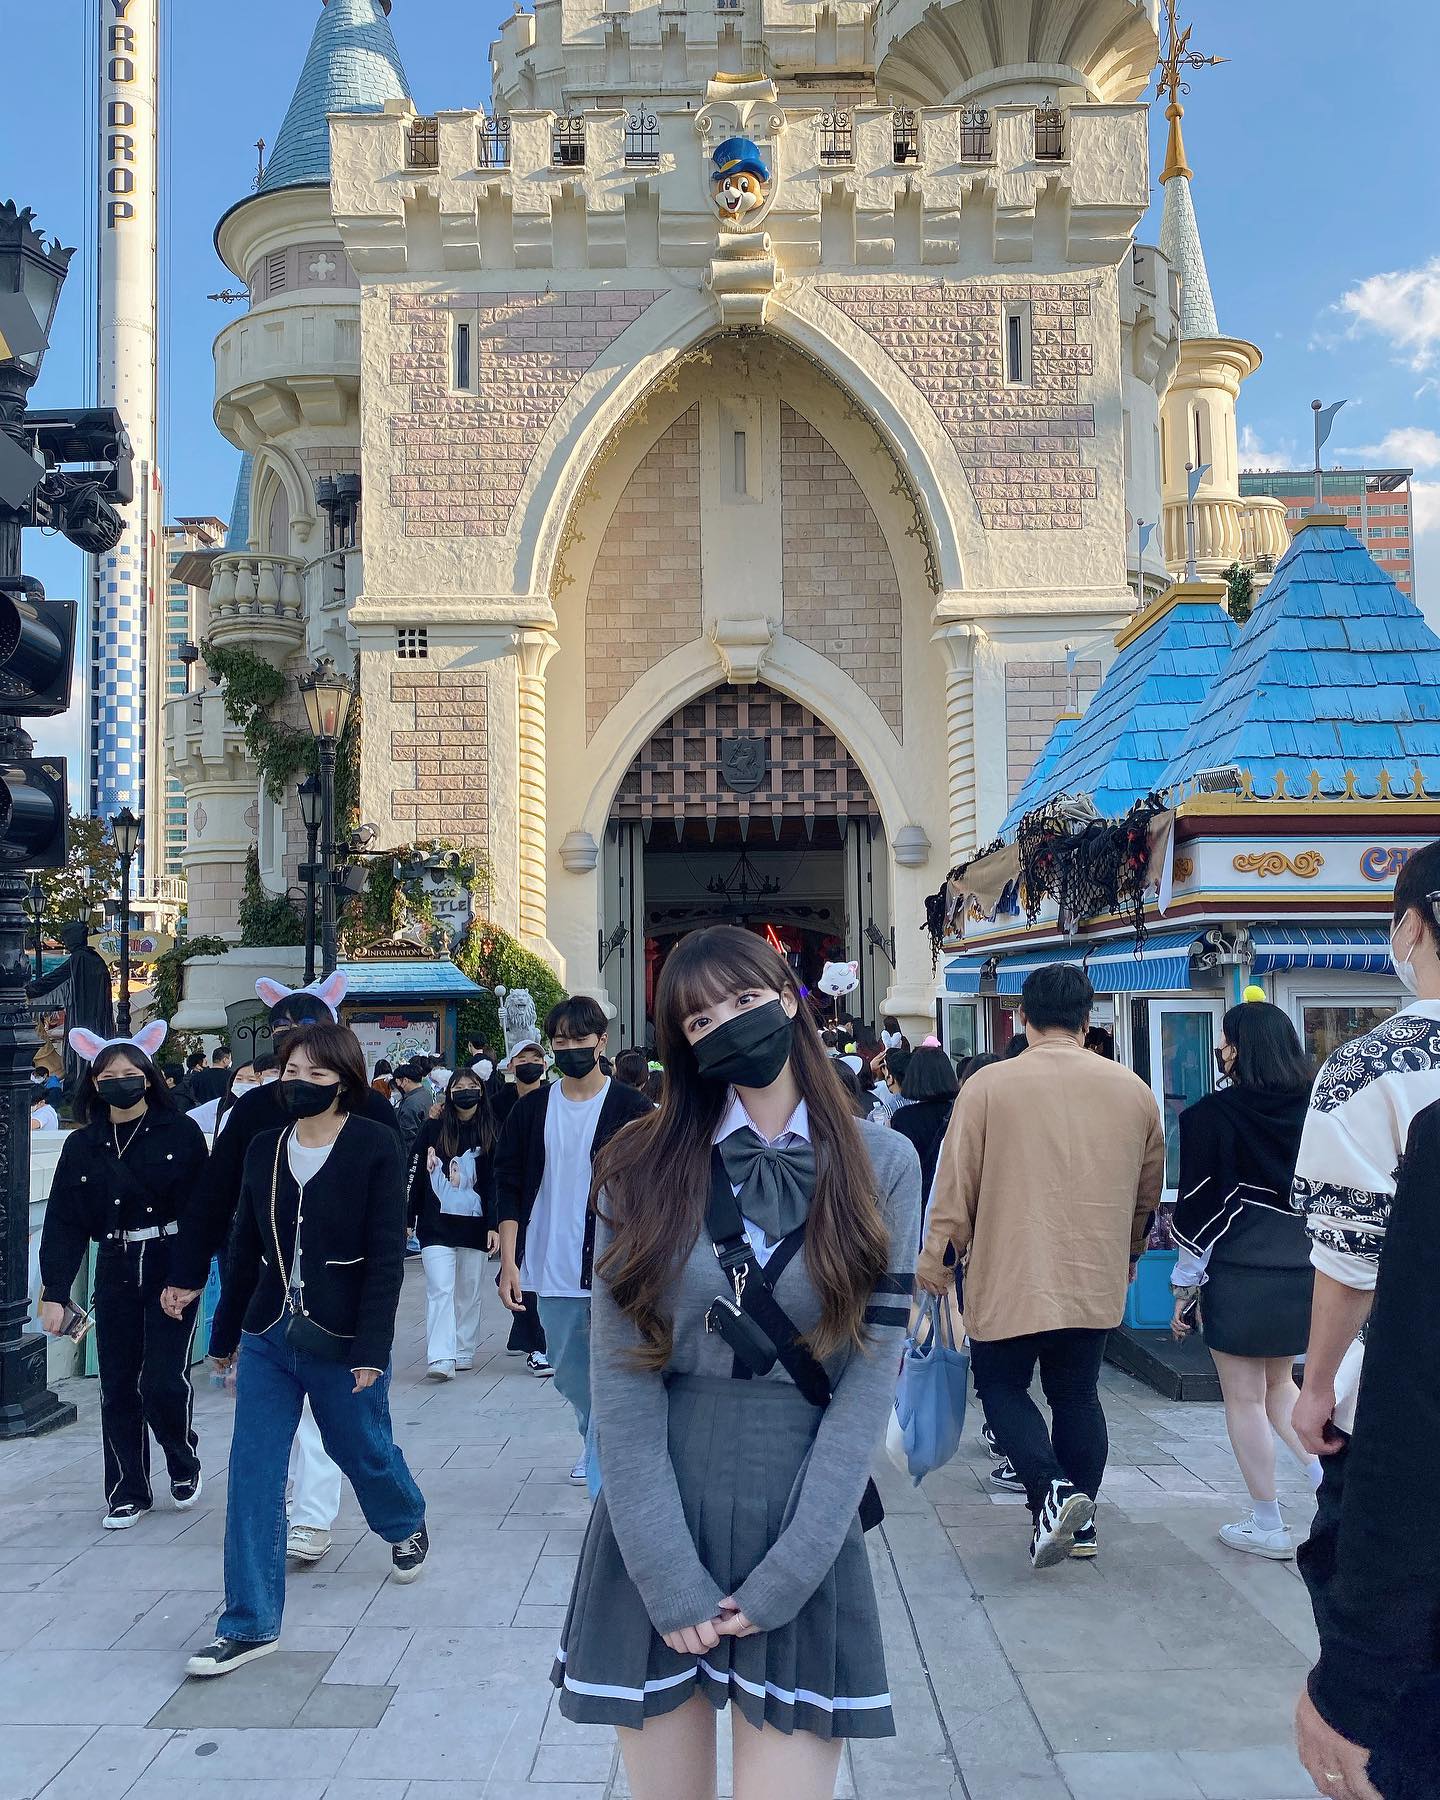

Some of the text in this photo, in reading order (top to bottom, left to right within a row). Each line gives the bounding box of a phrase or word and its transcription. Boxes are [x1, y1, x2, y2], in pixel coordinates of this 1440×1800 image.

[107, 101, 135, 229] DROP
[1360, 846, 1424, 882] CA
[367, 948, 421, 957] INFORMATION
